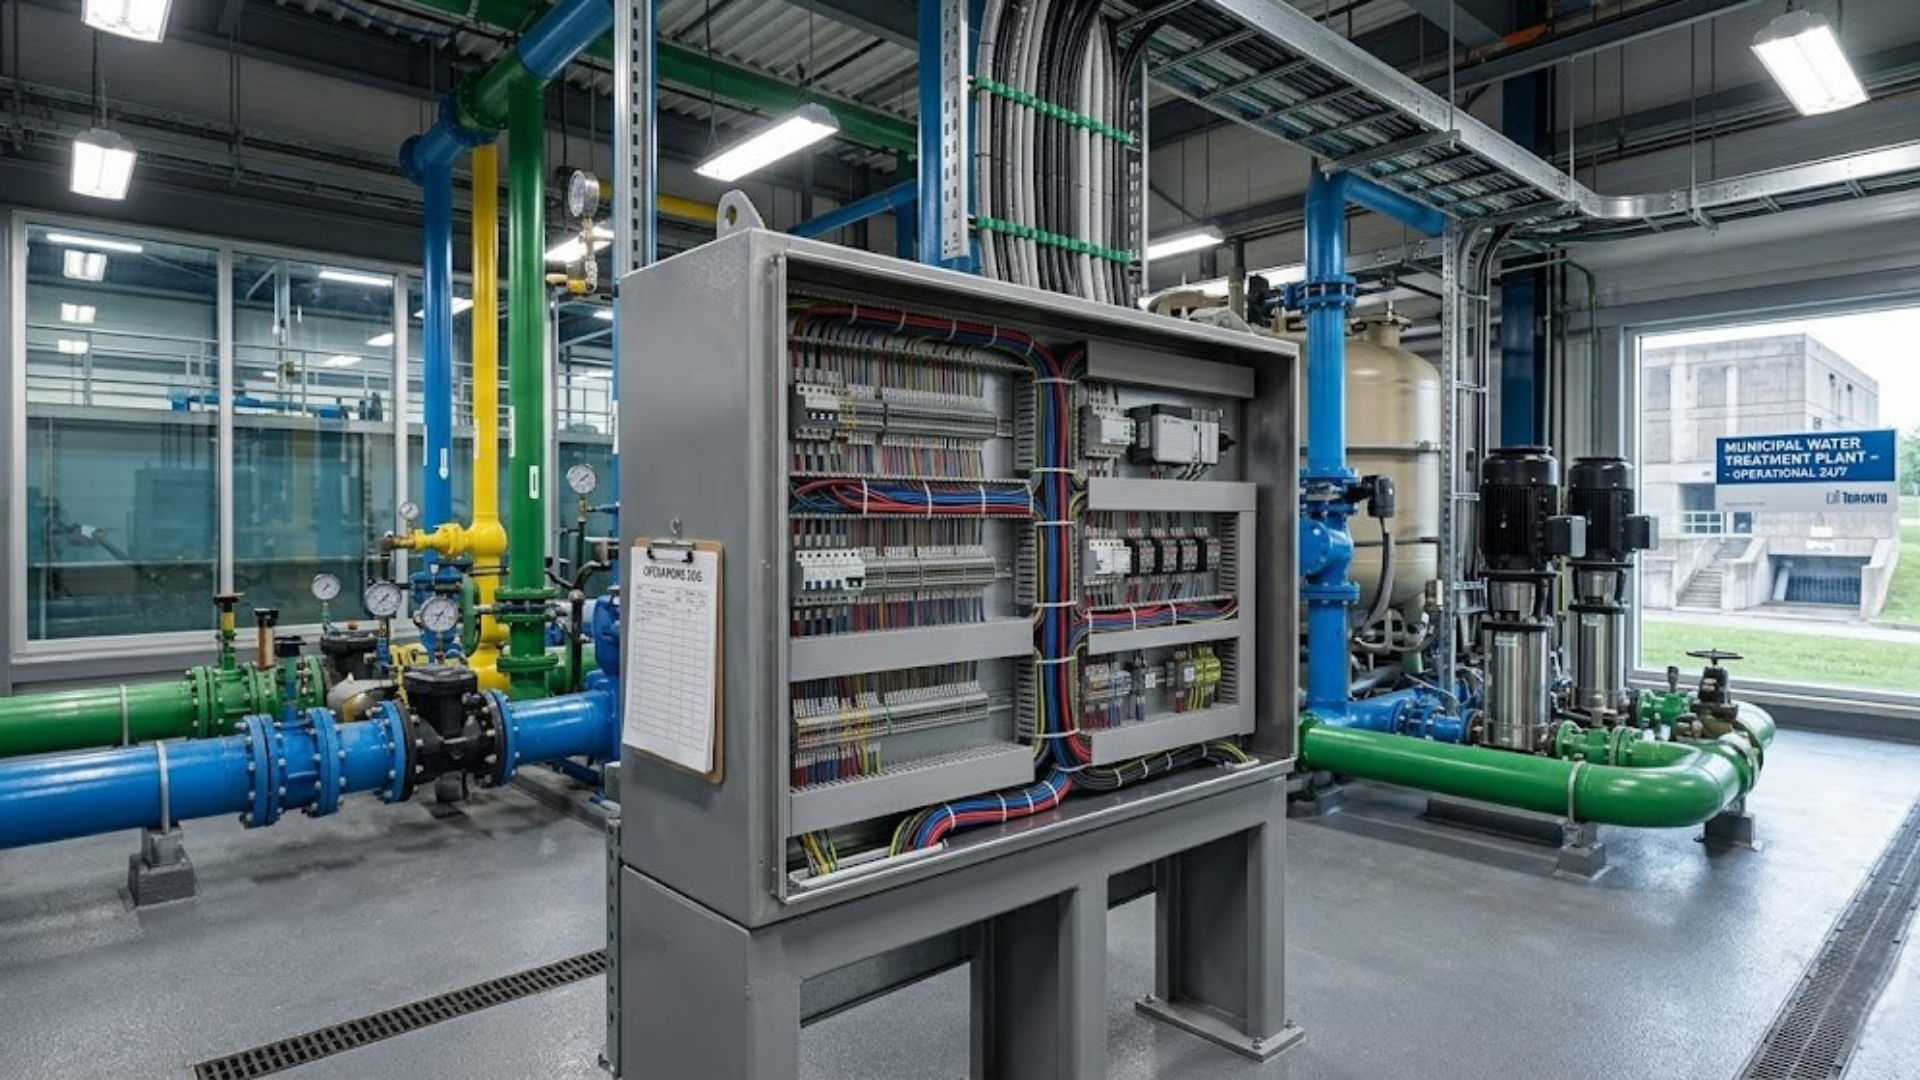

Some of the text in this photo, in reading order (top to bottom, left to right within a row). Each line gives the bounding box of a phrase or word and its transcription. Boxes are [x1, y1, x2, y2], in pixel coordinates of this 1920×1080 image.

[1724, 437, 1861, 453] MUNICIPAL WATER
[1724, 453, 1811, 467] TREATMENT
[1815, 451, 1866, 465] PLANT
[1733, 468, 1816, 480] OPERATIONAL
